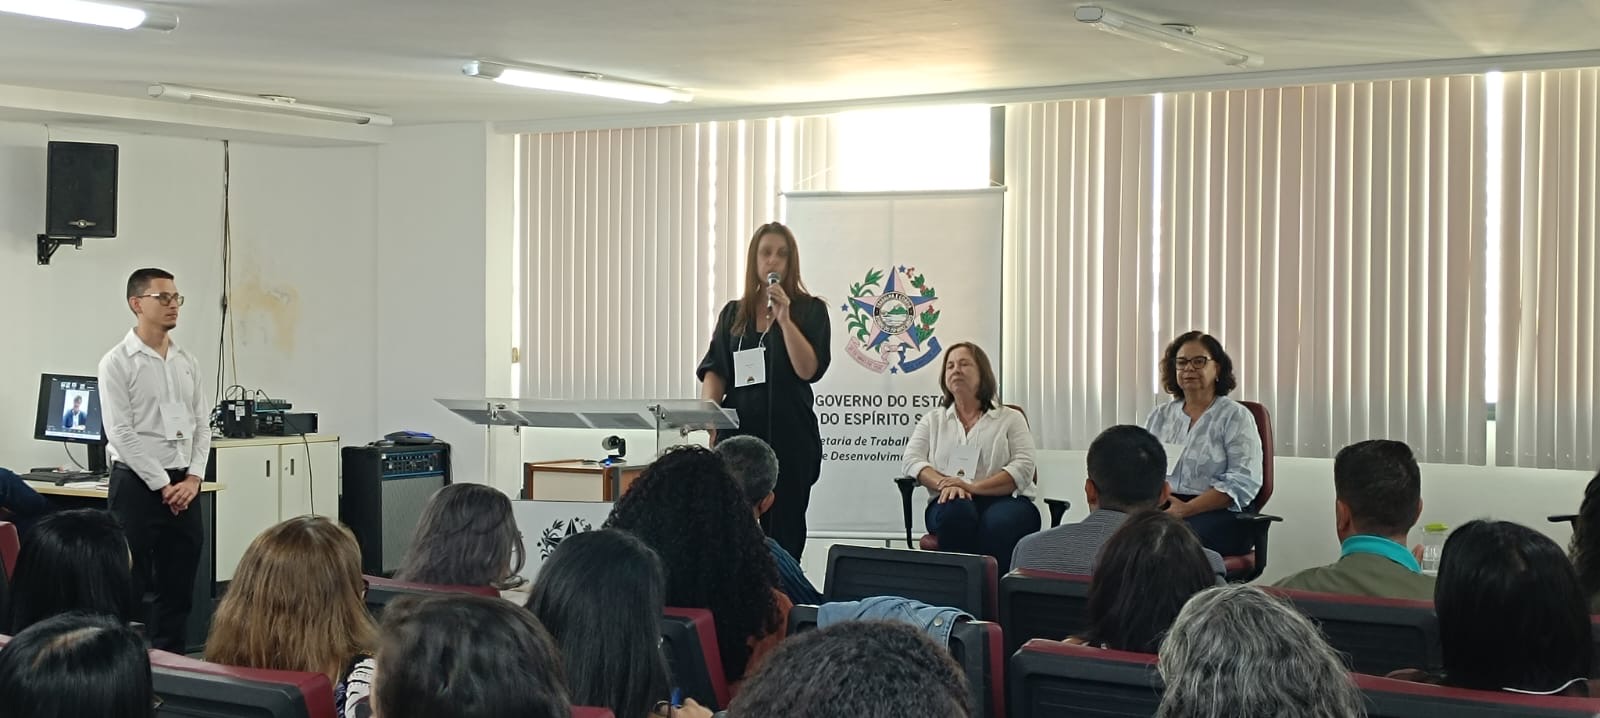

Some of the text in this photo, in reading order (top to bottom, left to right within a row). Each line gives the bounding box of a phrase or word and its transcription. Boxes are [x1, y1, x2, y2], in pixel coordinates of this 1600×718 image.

[815, 394, 945, 408] GOVERNO DO ESTA
[820, 412, 840, 425] DO
[844, 410, 910, 426] ESPÍRITO
[821, 436, 909, 446] etaria de Trabal
[830, 451, 904, 461] Desenvolvim
